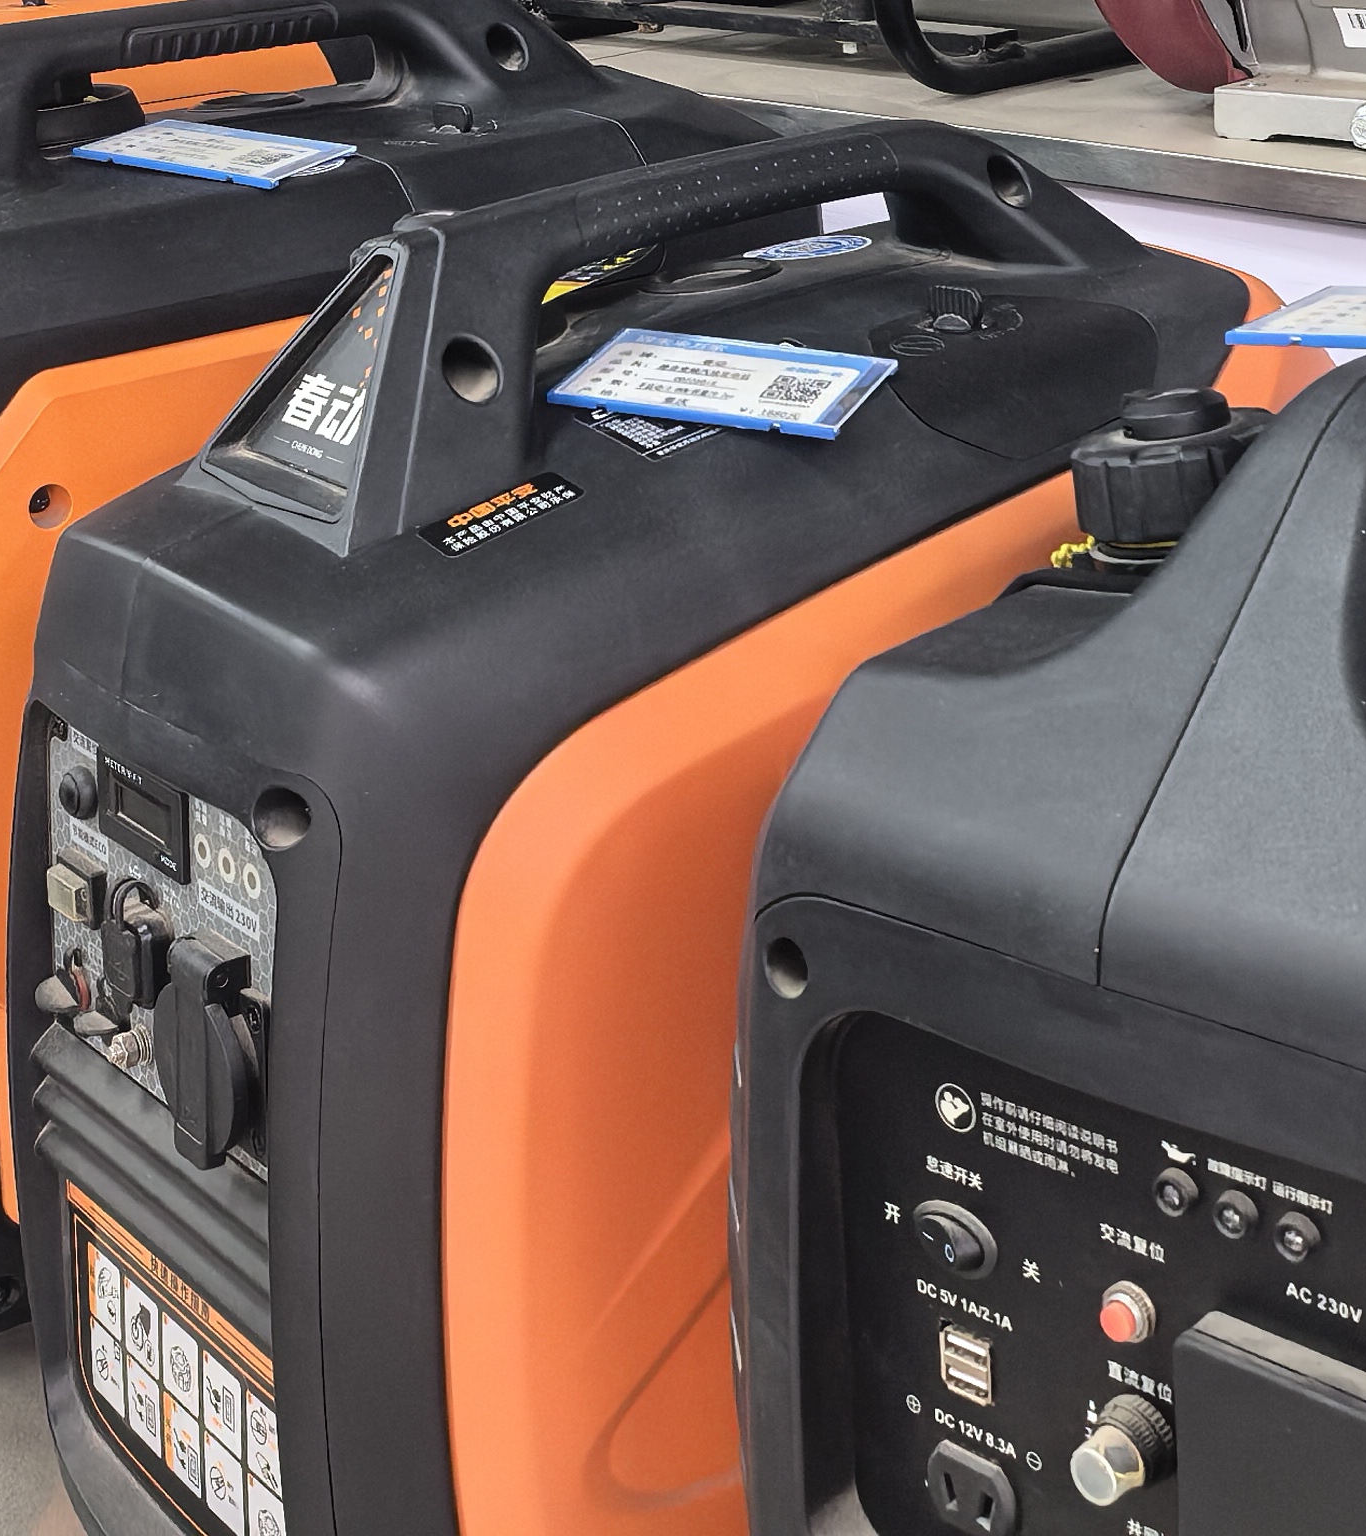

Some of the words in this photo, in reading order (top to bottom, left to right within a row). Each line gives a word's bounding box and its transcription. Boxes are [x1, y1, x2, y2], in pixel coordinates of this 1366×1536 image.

[281, 373, 367, 445] 春动
[235, 909, 258, 933] 230V
[925, 1154, 984, 1191] 怠速开关
[884, 1201, 901, 1224] 开
[1099, 1222, 1166, 1264] 交流复位
[1022, 1258, 1041, 1283] 关
[916, 1278, 937, 1299] DC
[939, 1288, 957, 1307] 5V
[960, 1298, 1013, 1332] 1A/2.1A
[1286, 1282, 1312, 1305] AC
[1317, 1293, 1364, 1326] 230V
[1107, 1360, 1174, 1405] 直流复位
[935, 1408, 956, 1429] DC
[958, 1418, 984, 1443] 12V
[985, 1431, 1017, 1459] 8.3A
